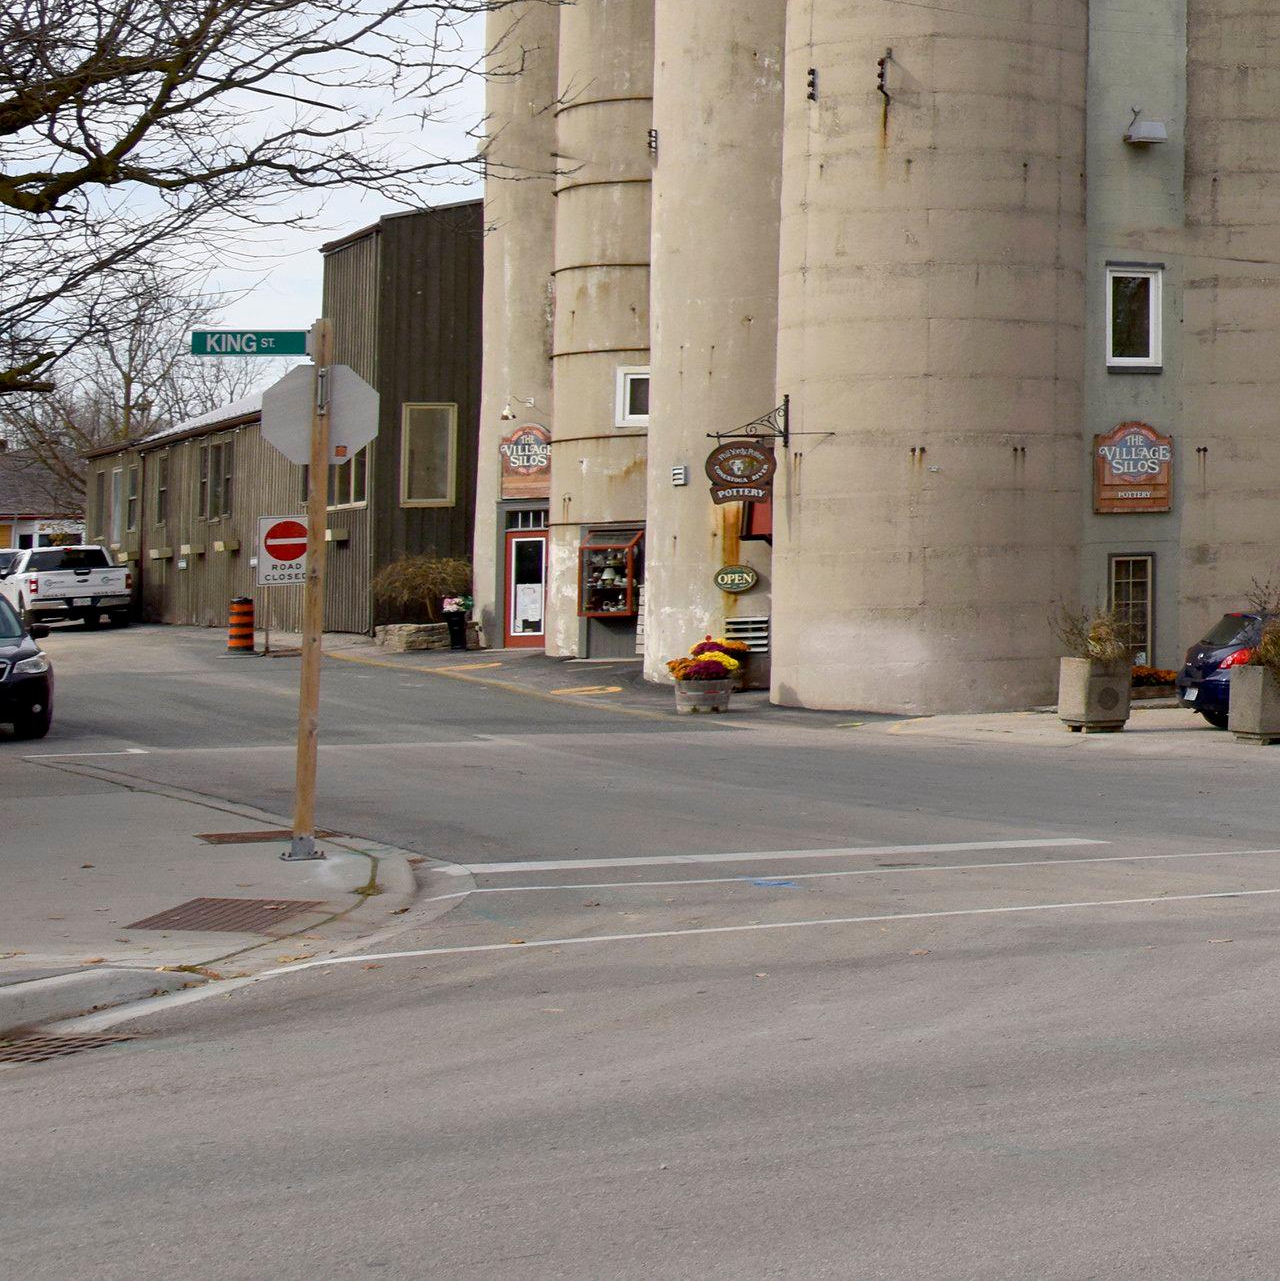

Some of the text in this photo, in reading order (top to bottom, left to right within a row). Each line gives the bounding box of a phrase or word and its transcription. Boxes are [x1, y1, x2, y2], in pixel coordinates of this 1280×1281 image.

[206, 333, 257, 352] KING
[520, 434, 535, 444] THE
[1125, 434, 1144, 446] THE
[1099, 445, 1170, 461] VILLAGE
[510, 454, 547, 467] SILOS
[1112, 459, 1159, 474] SILOS
[714, 464, 769, 483] CONESTOGA RIVER
[717, 488, 766, 498] POTTERY
[271, 563, 302, 571] ROAD
[717, 573, 752, 585] OPEN
